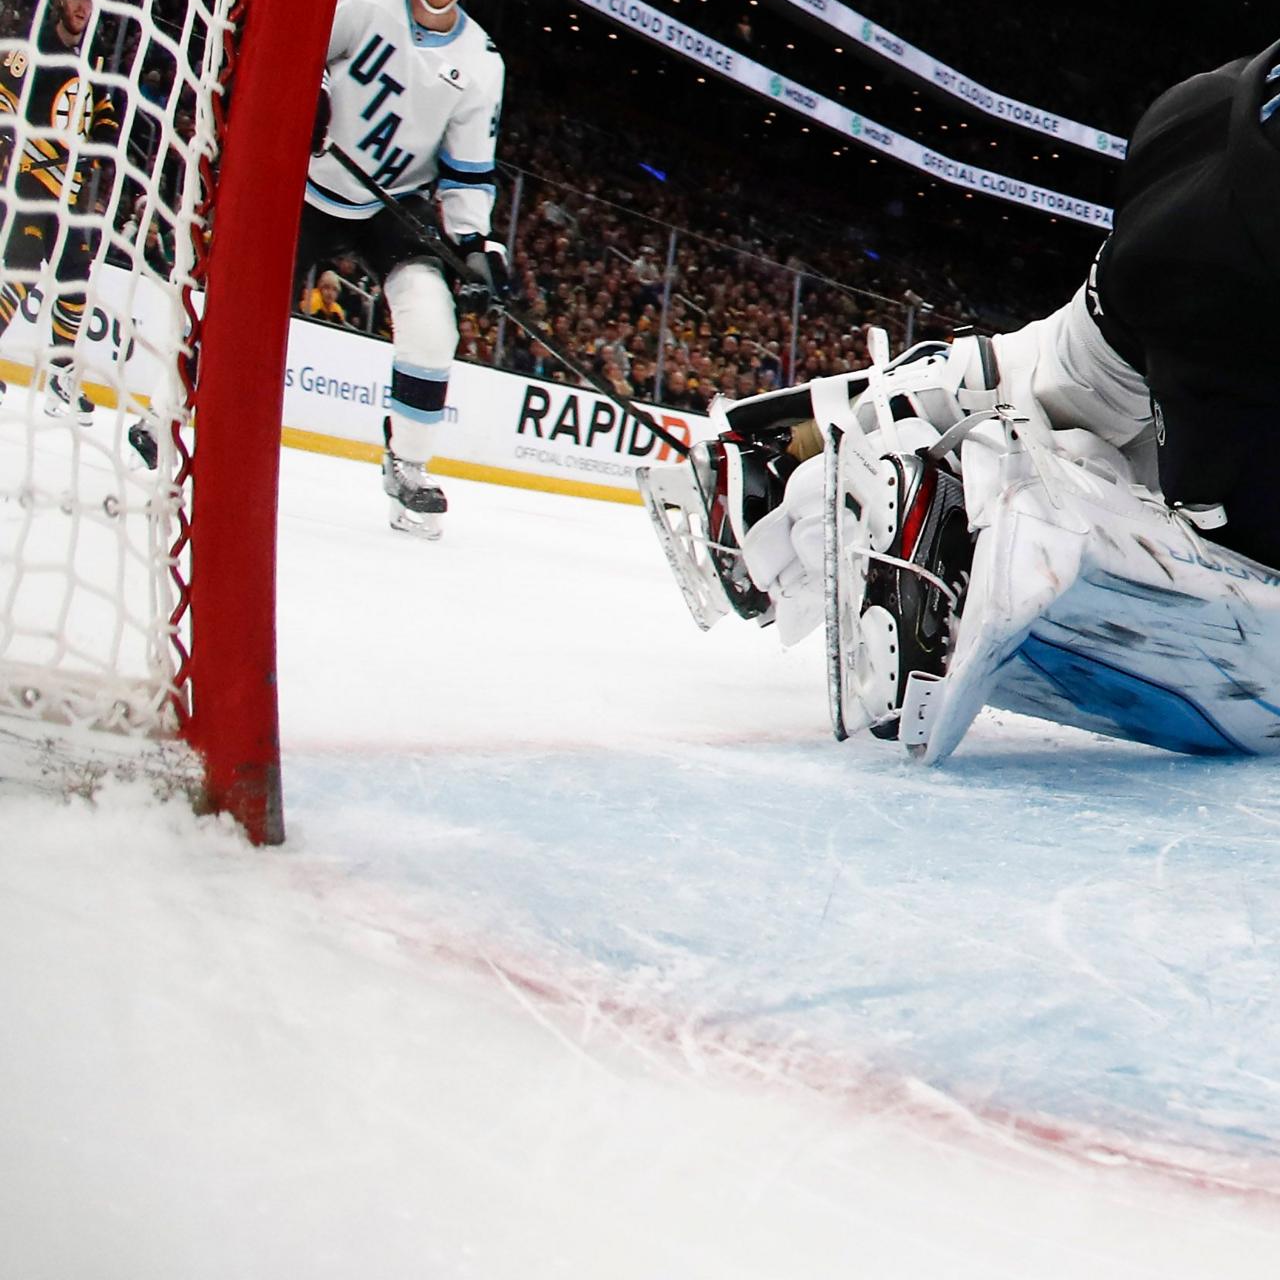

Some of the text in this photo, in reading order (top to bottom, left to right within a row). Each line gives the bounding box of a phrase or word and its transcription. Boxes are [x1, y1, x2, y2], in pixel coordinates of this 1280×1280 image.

[348, 33, 415, 189] UTAH
[666, 20, 734, 71] STORAGE
[921, 152, 977, 185] OFFICIAL
[980, 173, 1028, 201] CLOUD
[1031, 189, 1090, 220] STORAGE
[933, 64, 957, 89] HOT
[959, 80, 994, 111] CLOUD
[997, 95, 1060, 134] STORAGE
[299, 366, 378, 407] General
[514, 445, 563, 467] OFFICIAL
